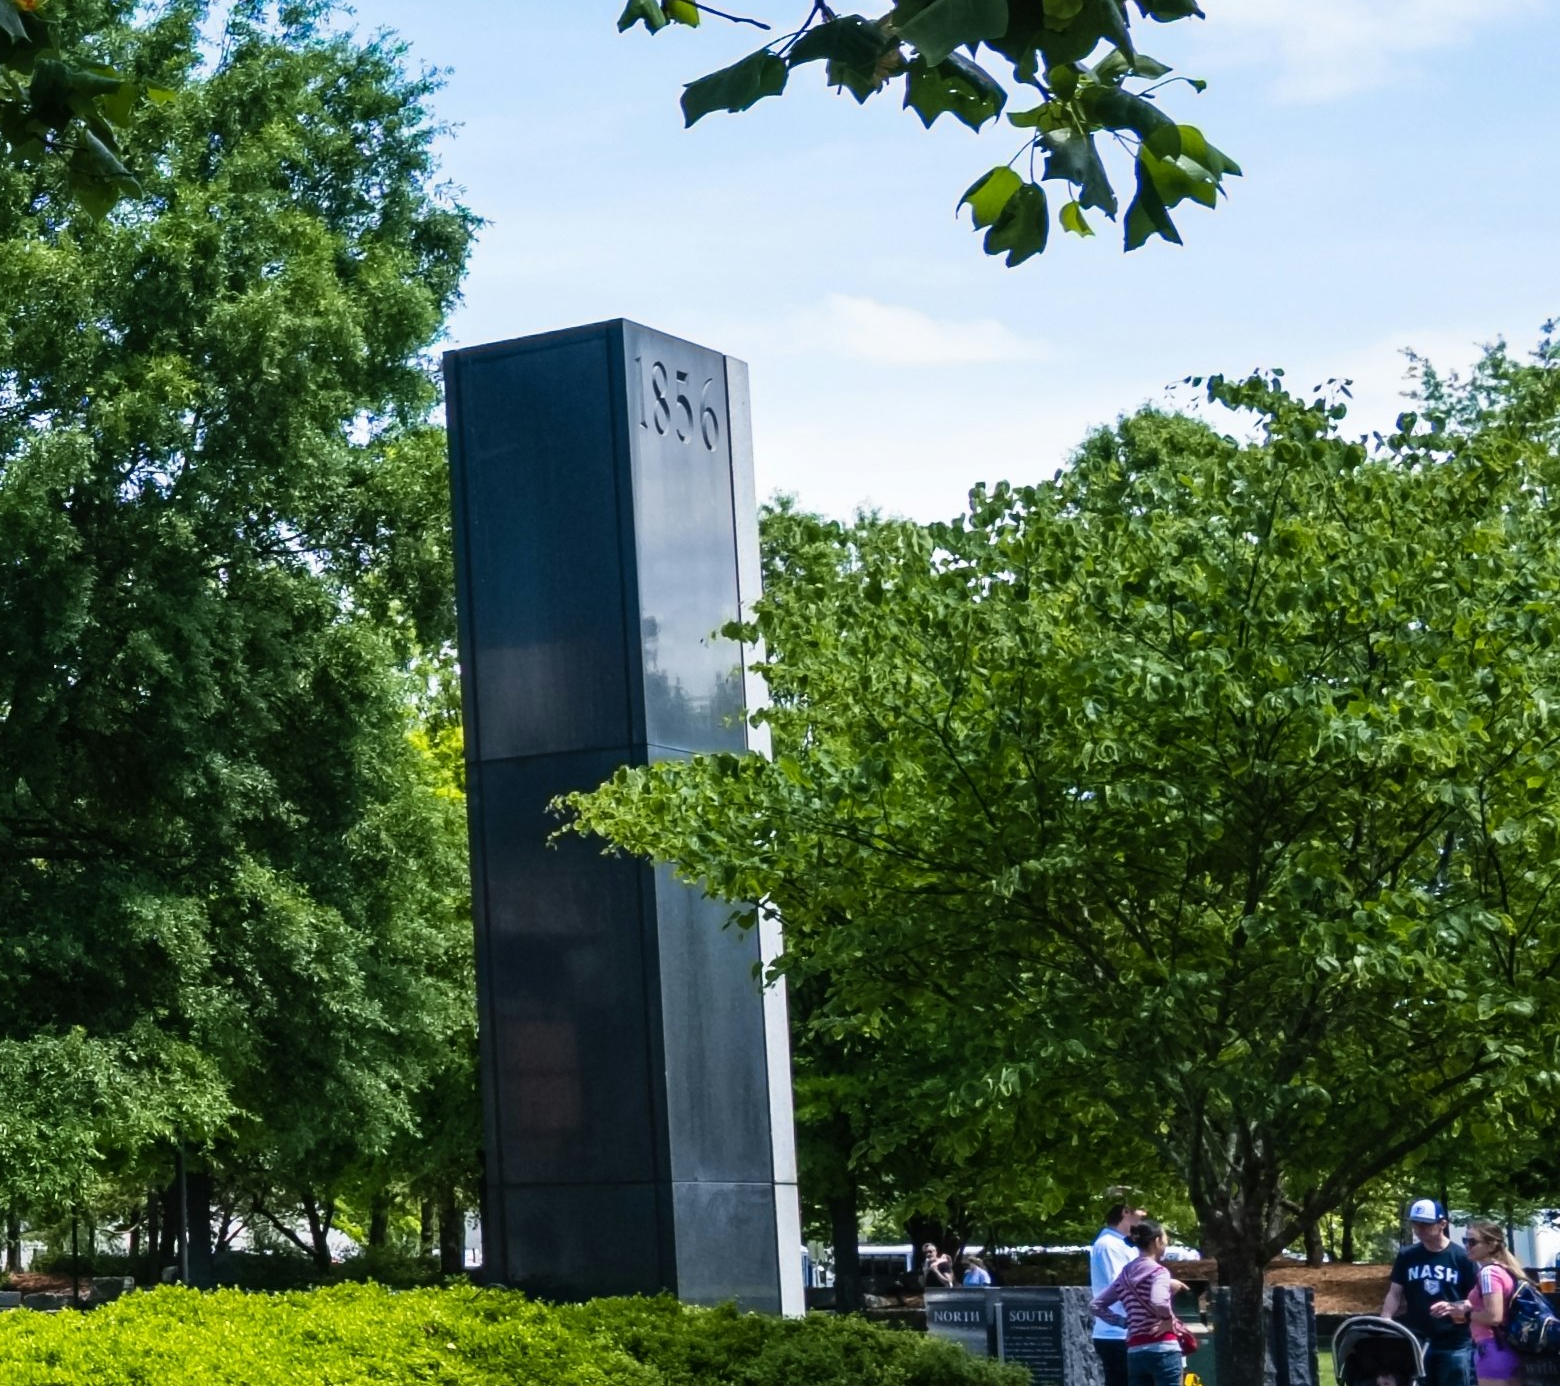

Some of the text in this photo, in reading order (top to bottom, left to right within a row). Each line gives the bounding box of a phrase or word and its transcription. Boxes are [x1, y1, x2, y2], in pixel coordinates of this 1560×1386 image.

[634, 356, 719, 452] 1856
[1407, 1264, 1459, 1286] NASH
[934, 1310, 980, 1323] NORTH
[1009, 1309, 1055, 1323] SOUTH
